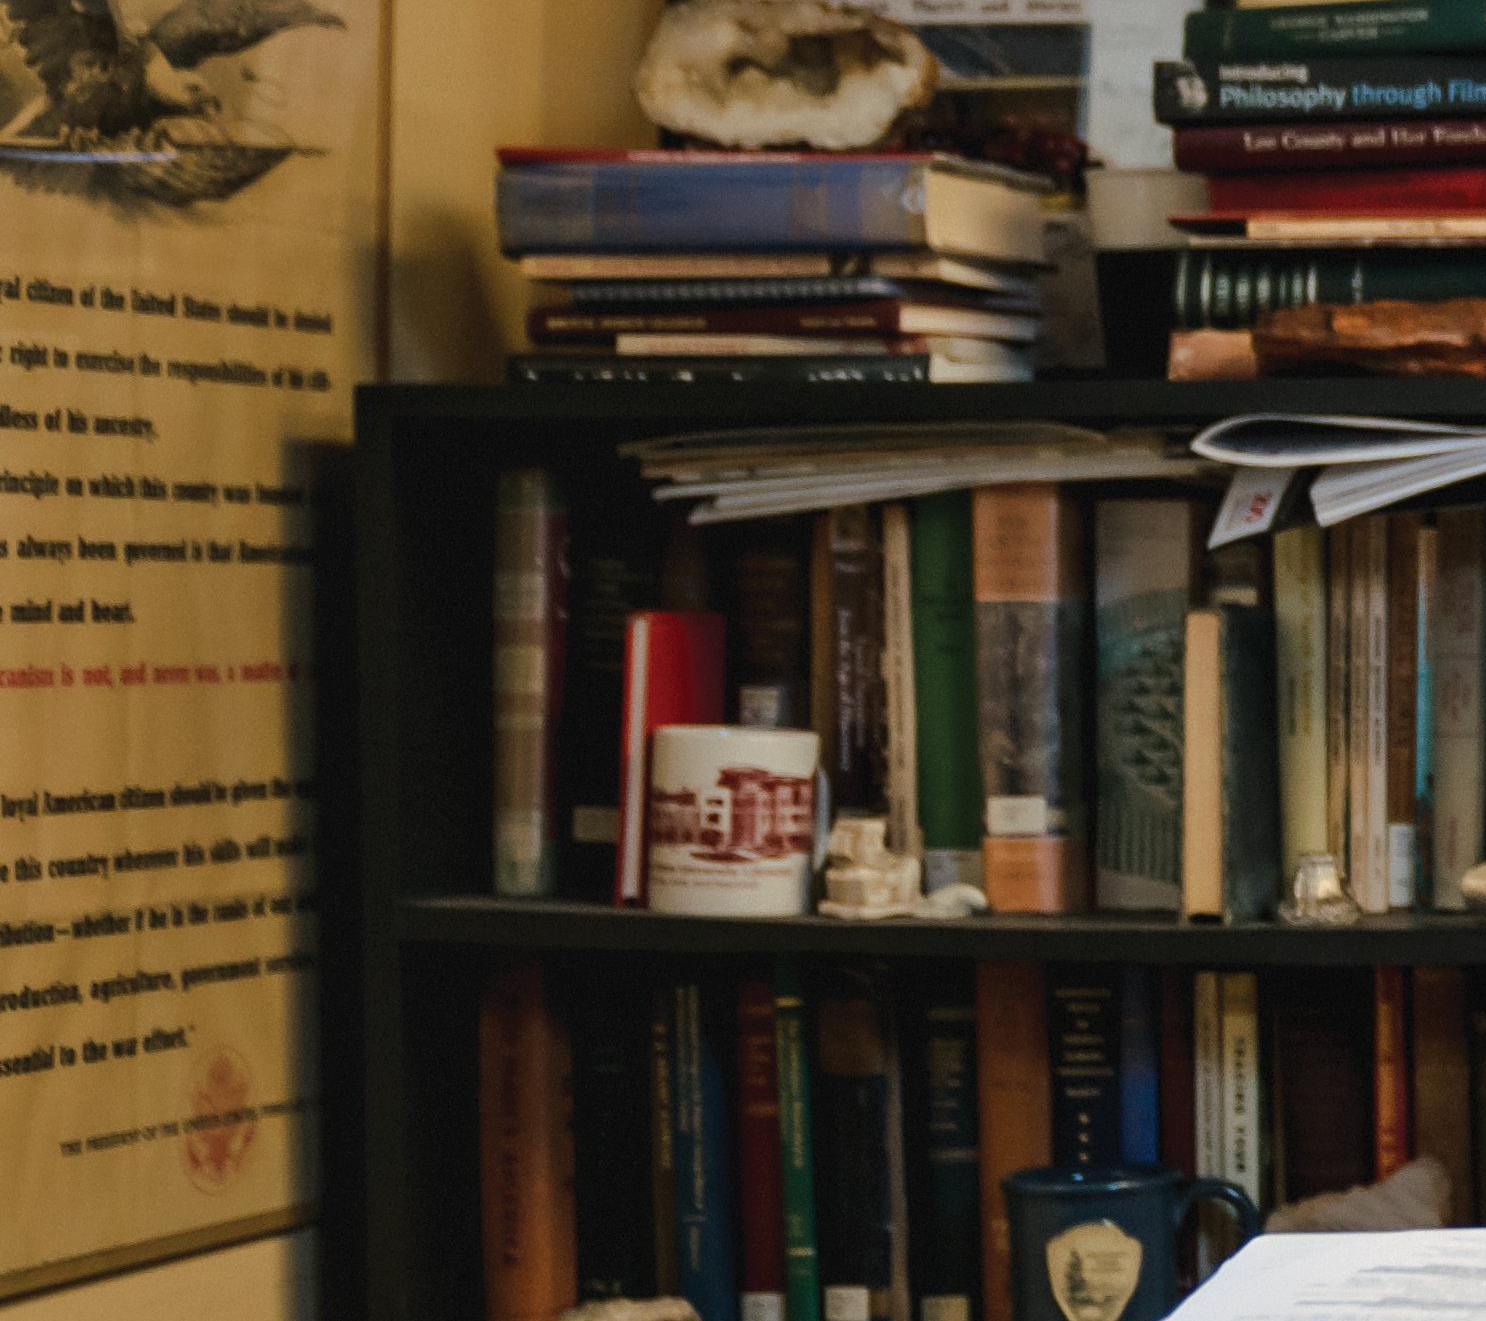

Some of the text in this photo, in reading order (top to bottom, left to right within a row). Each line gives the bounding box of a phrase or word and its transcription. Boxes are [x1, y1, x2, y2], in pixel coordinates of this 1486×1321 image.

[1219, 81, 1347, 112] Philosophy
[1352, 79, 1442, 109] through
[16, 533, 73, 565] always
[0, 980, 83, 1014] roduction,
